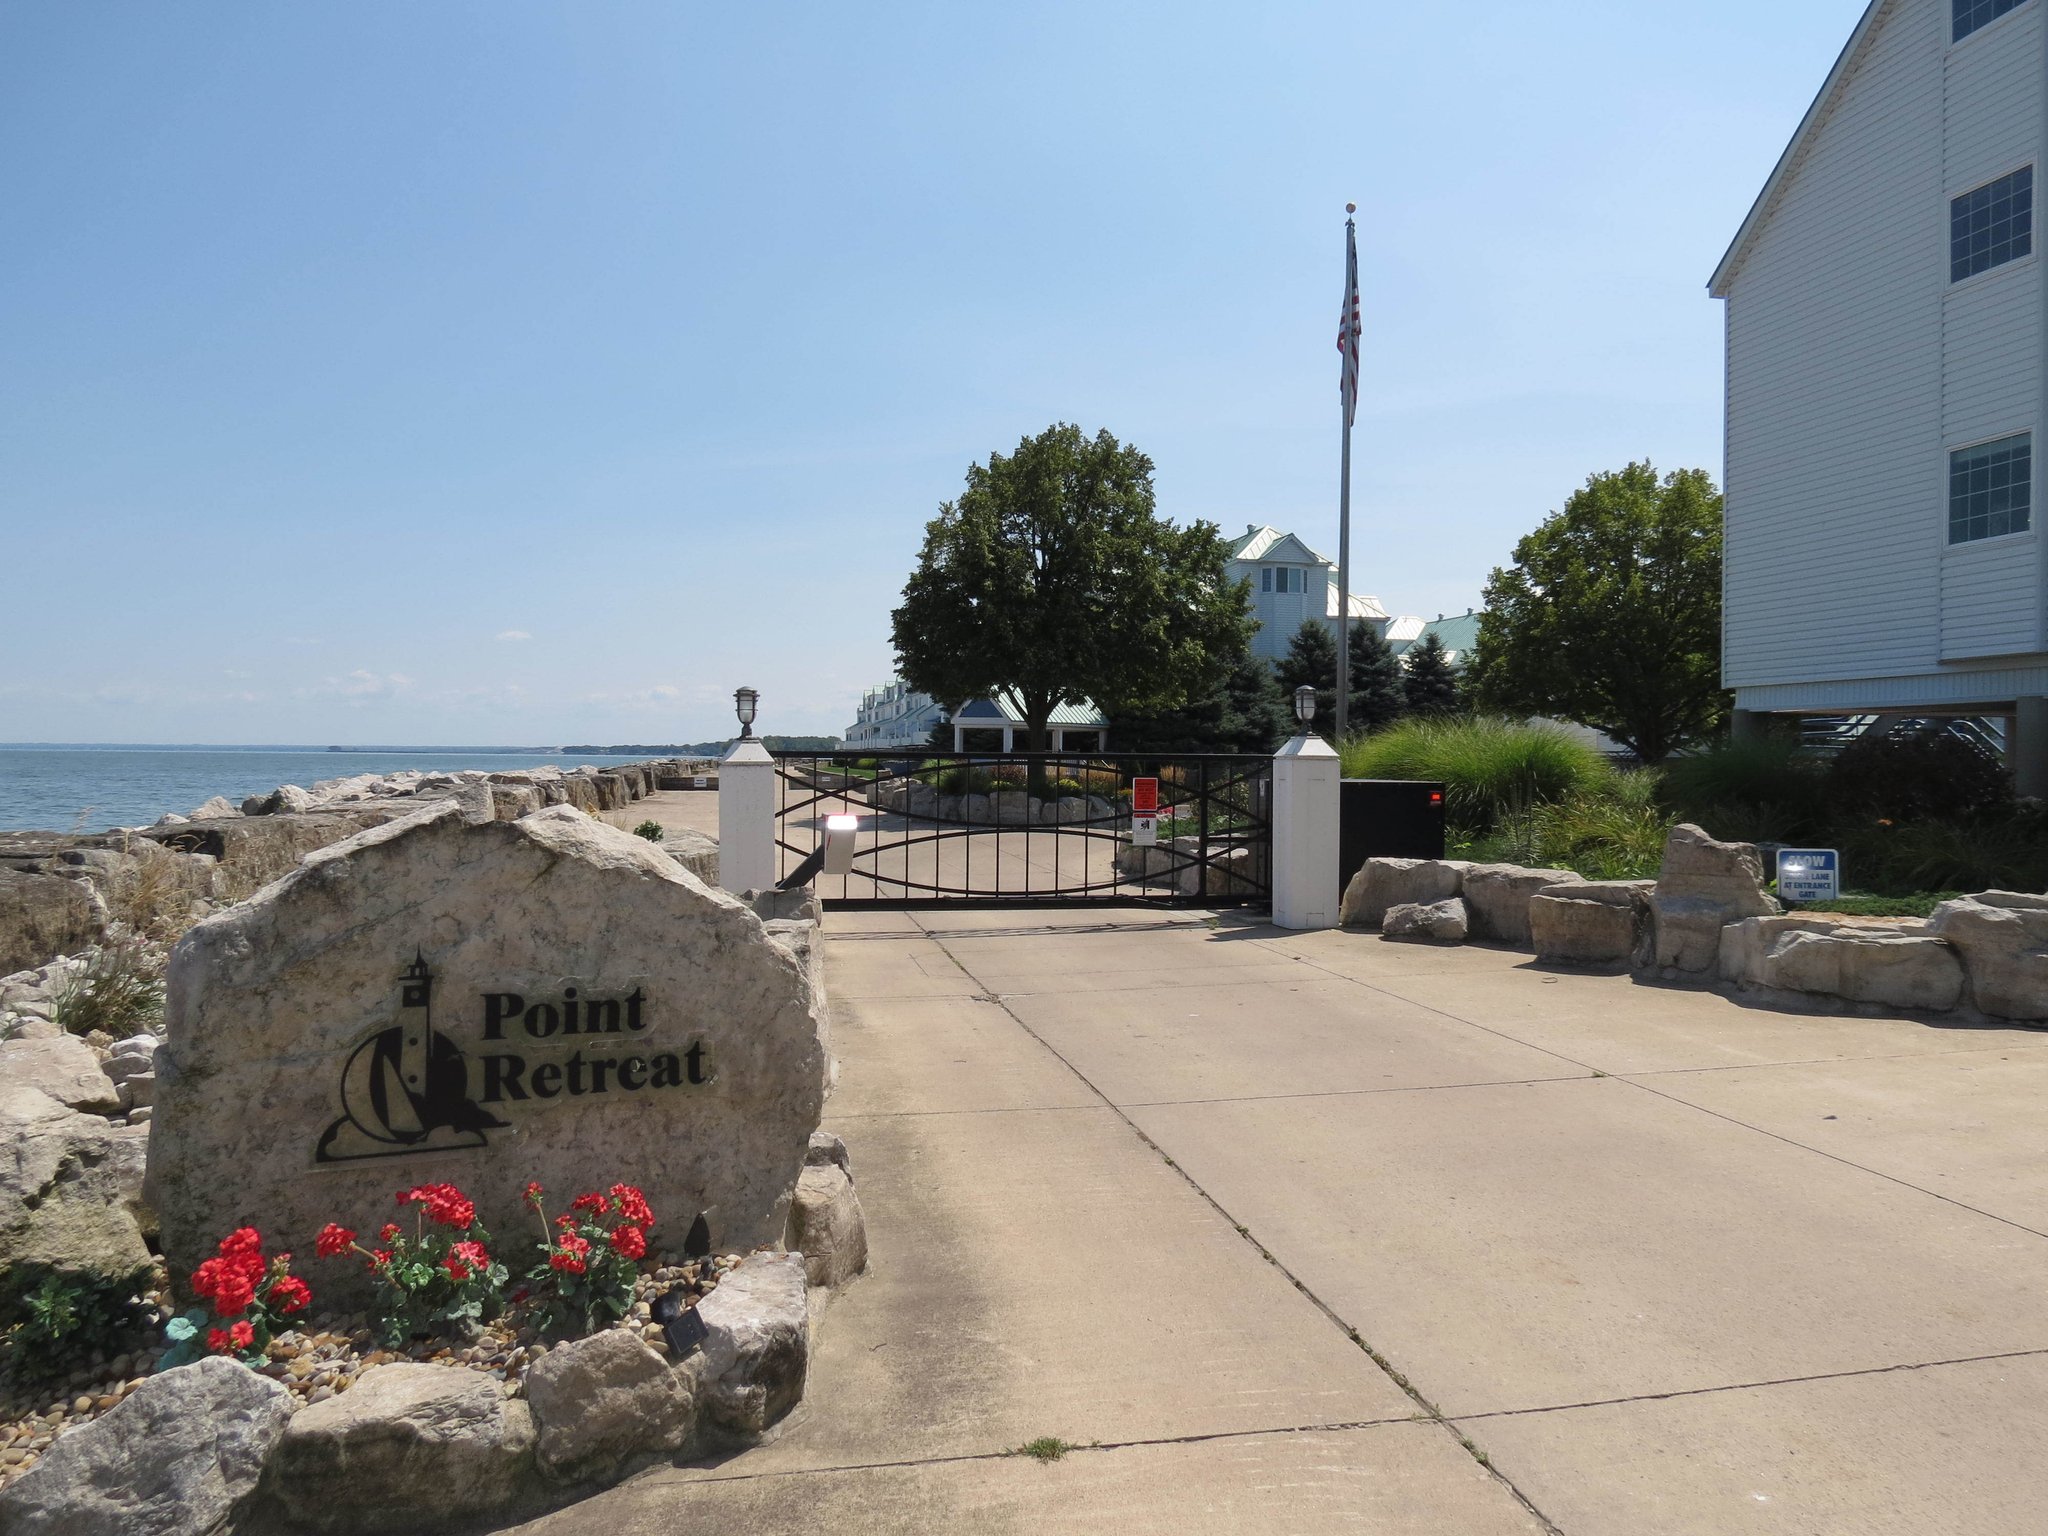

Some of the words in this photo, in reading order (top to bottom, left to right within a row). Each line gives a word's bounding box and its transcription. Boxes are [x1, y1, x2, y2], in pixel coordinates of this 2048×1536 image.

[1789, 856, 1825, 866] SLOW
[480, 987, 647, 1040] Point
[479, 1041, 707, 1103] Retreat
